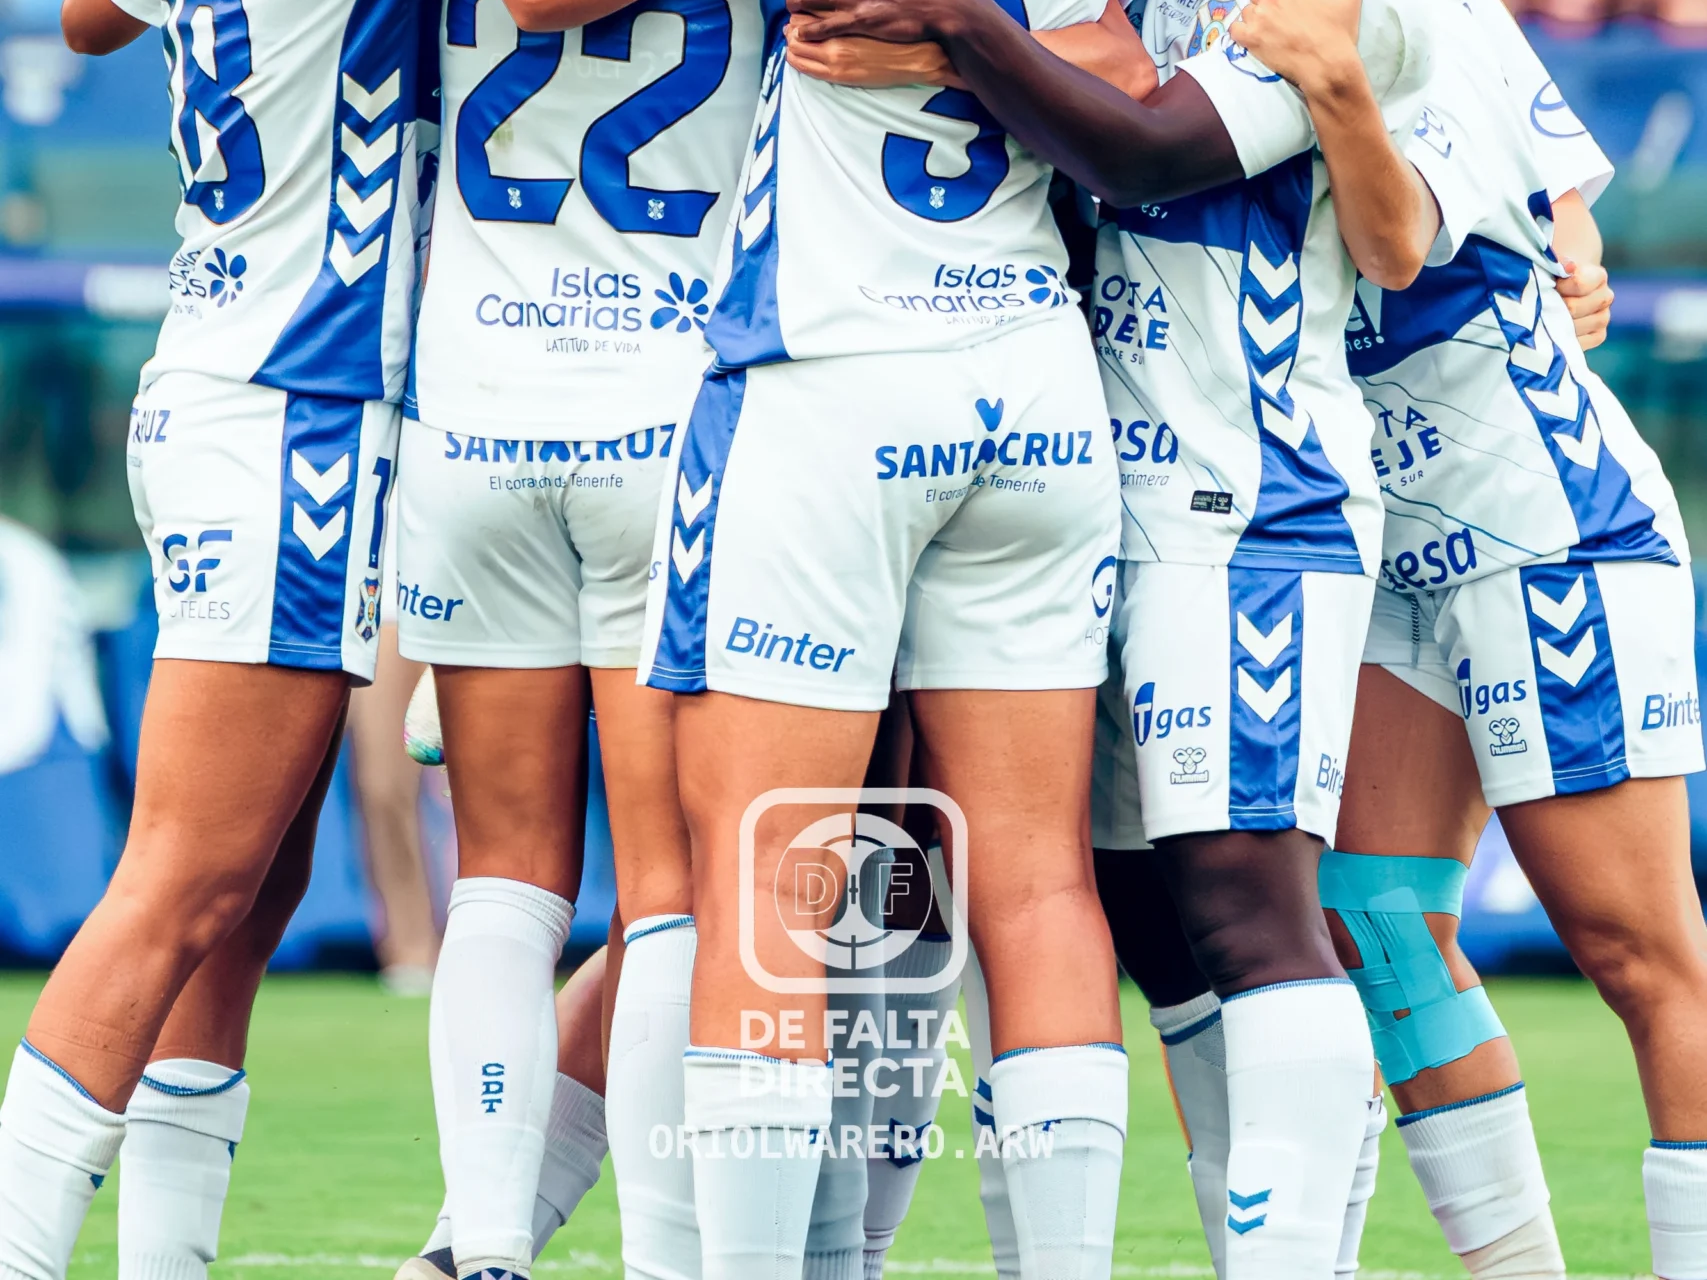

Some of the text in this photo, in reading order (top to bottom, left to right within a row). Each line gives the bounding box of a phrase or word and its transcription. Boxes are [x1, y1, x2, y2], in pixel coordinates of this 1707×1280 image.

[551, 267, 641, 300] Islas
[933, 264, 1017, 289] Islas
[857, 285, 1026, 314] Canarias
[475, 293, 643, 332] Canarias
[594, 339, 610, 353] DE
[613, 340, 641, 355] VIDA
[571, 472, 623, 488] Tenerife
[989, 474, 1047, 494] Tenerife
[725, 616, 855, 673] Binter
[1641, 691, 1701, 731] Binte
[1490, 740, 1528, 757] hummel
[1170, 770, 1210, 786] hummel
